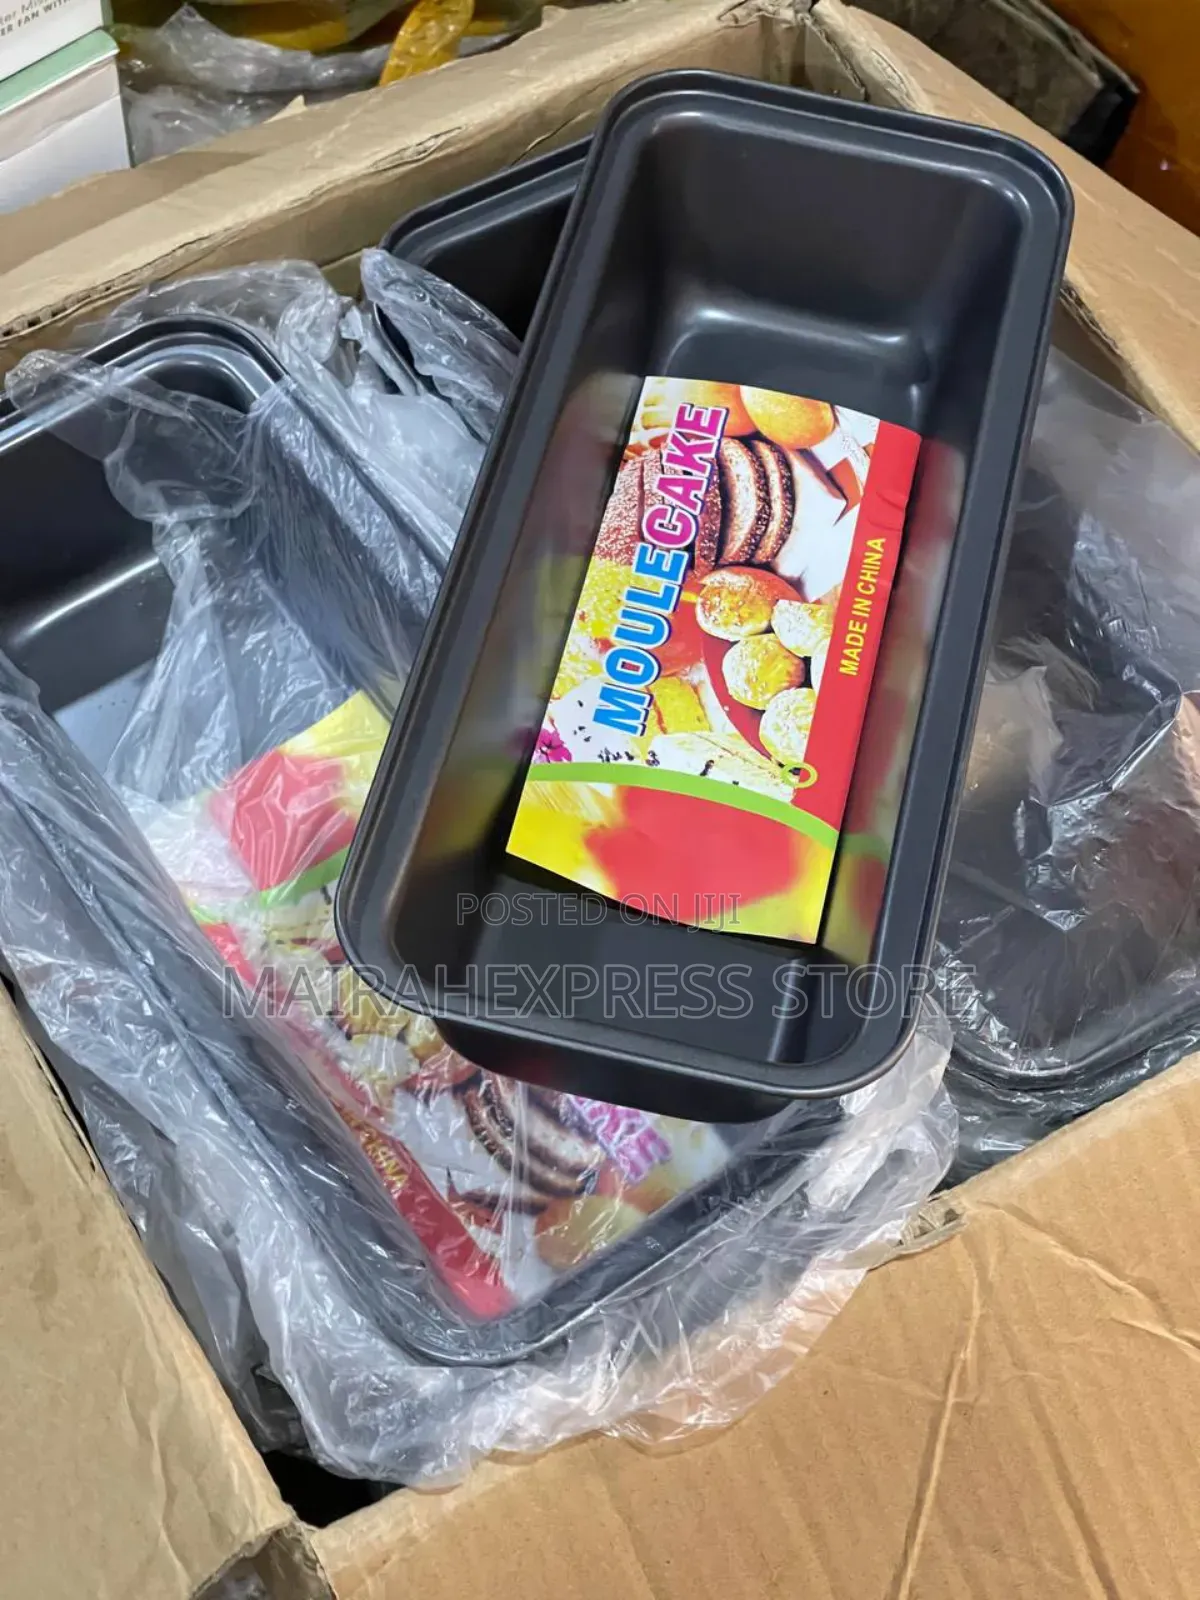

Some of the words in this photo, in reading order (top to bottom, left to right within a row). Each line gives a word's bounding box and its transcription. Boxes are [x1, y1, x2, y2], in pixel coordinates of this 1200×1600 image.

[17, 9, 40, 28] FAN
[856, 537, 887, 595] CHINA
[851, 597, 873, 618] IN
[838, 619, 868, 676] MADE
